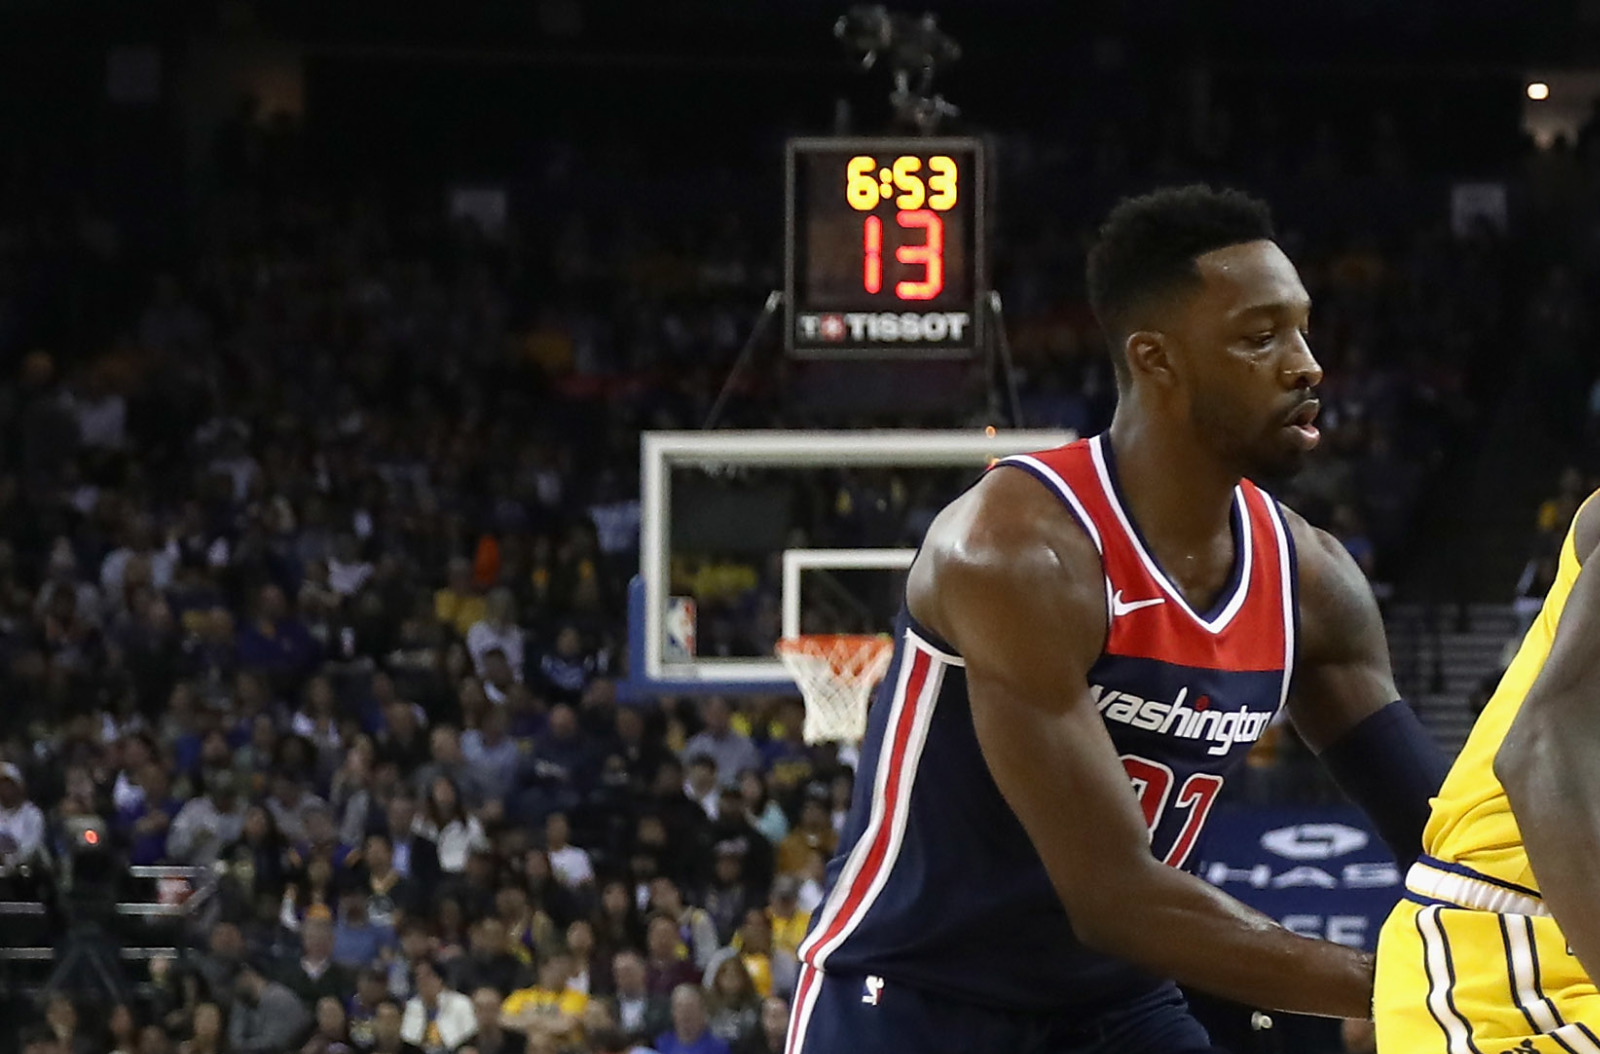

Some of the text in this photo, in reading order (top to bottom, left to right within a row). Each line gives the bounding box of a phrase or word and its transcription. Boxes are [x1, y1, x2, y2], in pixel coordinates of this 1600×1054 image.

[846, 155, 958, 211] 6:53
[863, 209, 945, 300] 13
[844, 312, 970, 342] TISSOT
